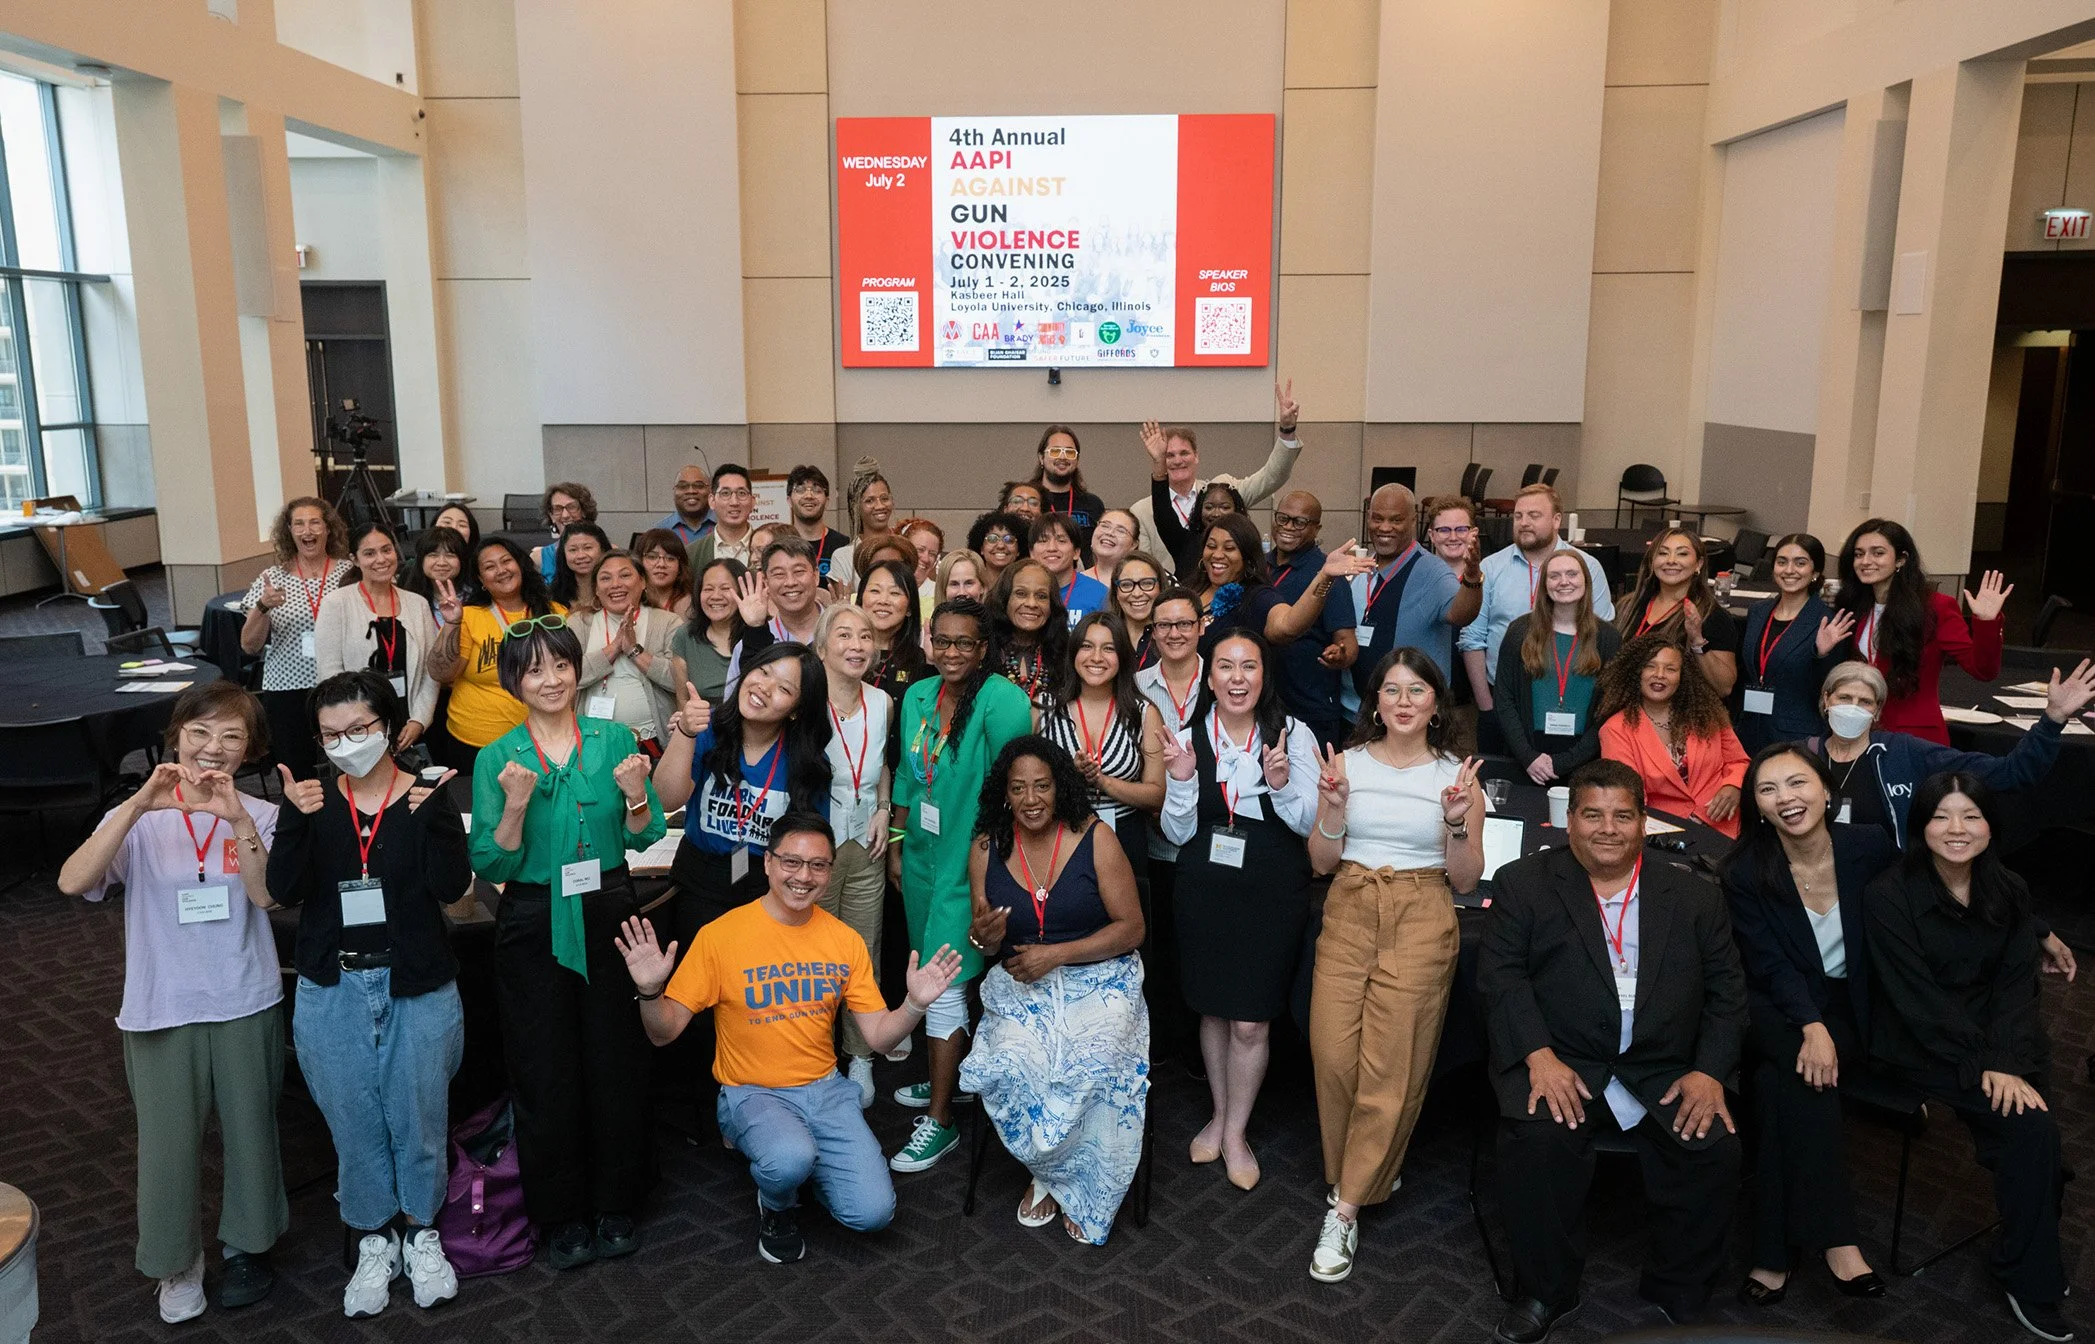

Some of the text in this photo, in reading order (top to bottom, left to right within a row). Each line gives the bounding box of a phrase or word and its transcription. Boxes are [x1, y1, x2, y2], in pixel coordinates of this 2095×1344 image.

[949, 127, 1065, 146] 4th Annual
[842, 156, 928, 169] WEDNESDAY
[950, 150, 1011, 170] AAPI
[865, 173, 906, 190] July 2
[950, 176, 1066, 197] AGAINST
[951, 204, 1008, 223] GUN
[2047, 216, 2090, 237] EXIT
[951, 230, 1080, 249] VIOLENCE
[951, 253, 1074, 269] CONVENING
[861, 277, 916, 287] PROGRAM
[950, 276, 979, 290] July
[985, 276, 994, 287] 1
[1030, 275, 1070, 287] 2025
[1198, 269, 1248, 279] SPEAKER
[951, 290, 1025, 300] Kasbeer Hall
[1210, 282, 1236, 292] BIOS
[951, 302, 987, 313] Loyola
[1111, 301, 1151, 311] Illinois
[972, 322, 1000, 340] CAA
[1126, 319, 1164, 337] Joyce
[1004, 334, 1034, 343] BRADY
[1097, 349, 1136, 358] GIFFORDS
[707, 814, 749, 837] LIVES
[743, 962, 850, 984] TEACHERS
[744, 978, 847, 1010] UNIFY
[765, 1014, 786, 1024] END
[790, 1010, 808, 1019] GUN
